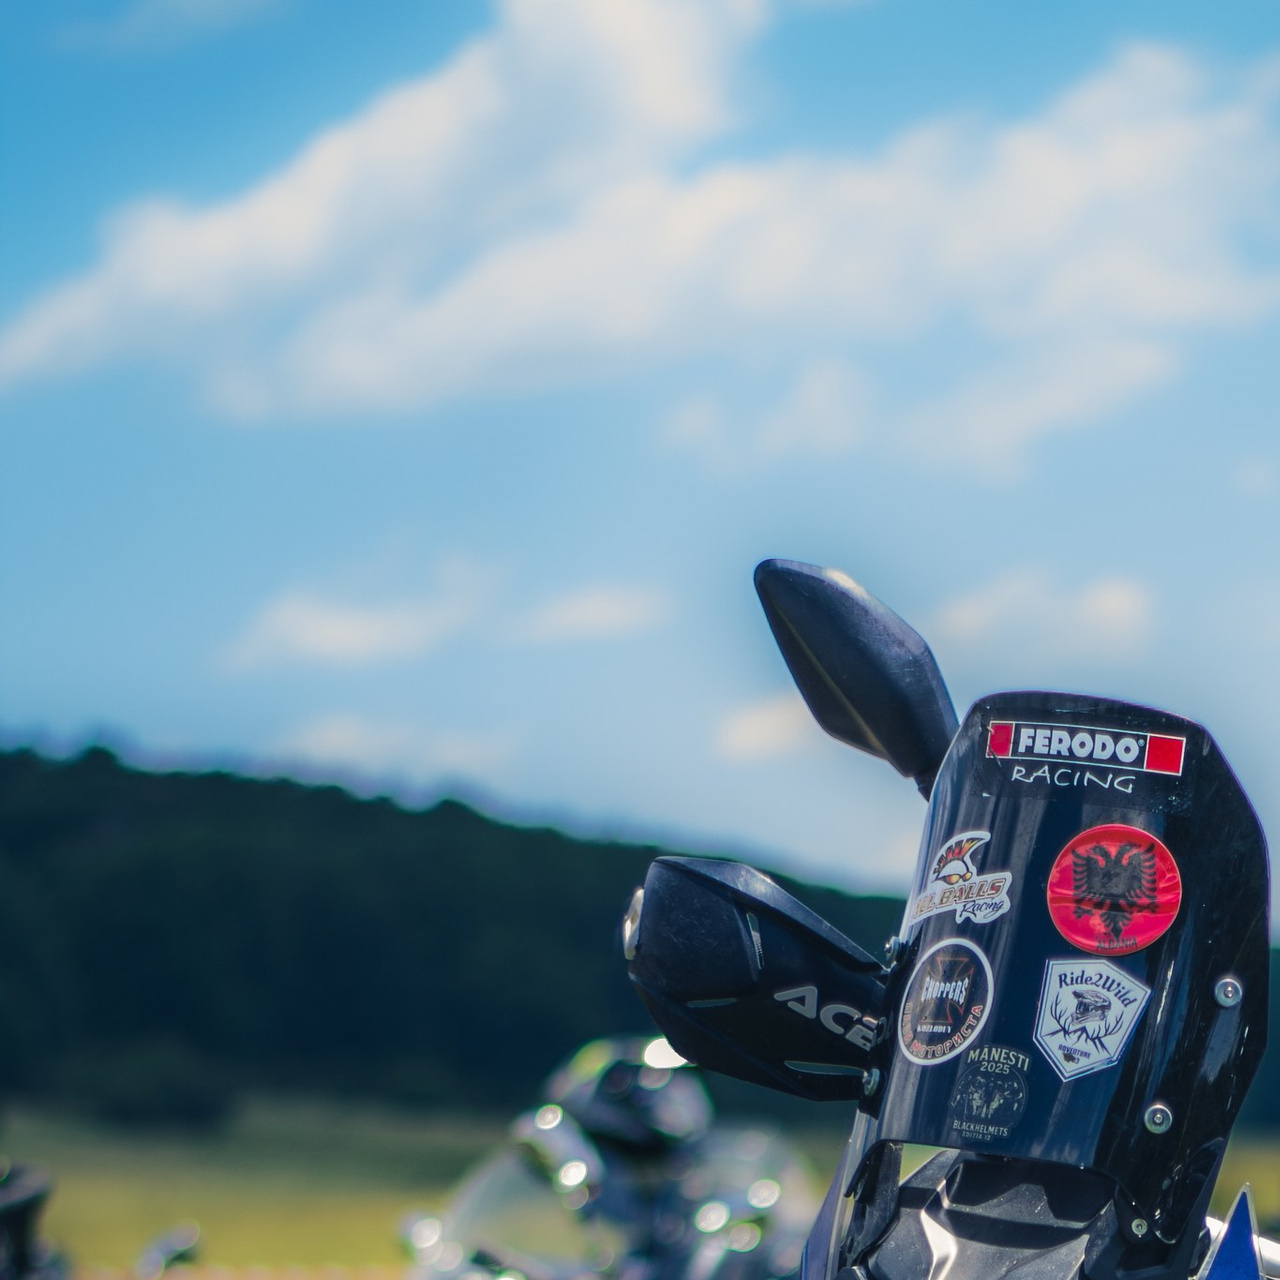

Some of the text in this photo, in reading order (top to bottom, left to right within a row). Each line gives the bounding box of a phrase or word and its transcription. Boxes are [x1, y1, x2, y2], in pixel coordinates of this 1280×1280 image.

[1011, 765, 1136, 793] RACING
[936, 878, 1006, 908] BALLS
[959, 900, 1005, 918] Racing
[921, 975, 969, 1005] CHOPPERS
[1058, 970, 1138, 1008] Ride2Wild
[910, 1005, 983, 1058] МОТОРИСТА
[1058, 1044, 1091, 1059] ADVENTURE
[980, 1062, 1010, 1074] 2025
[953, 1120, 1009, 1136] BLACKHELMETS
